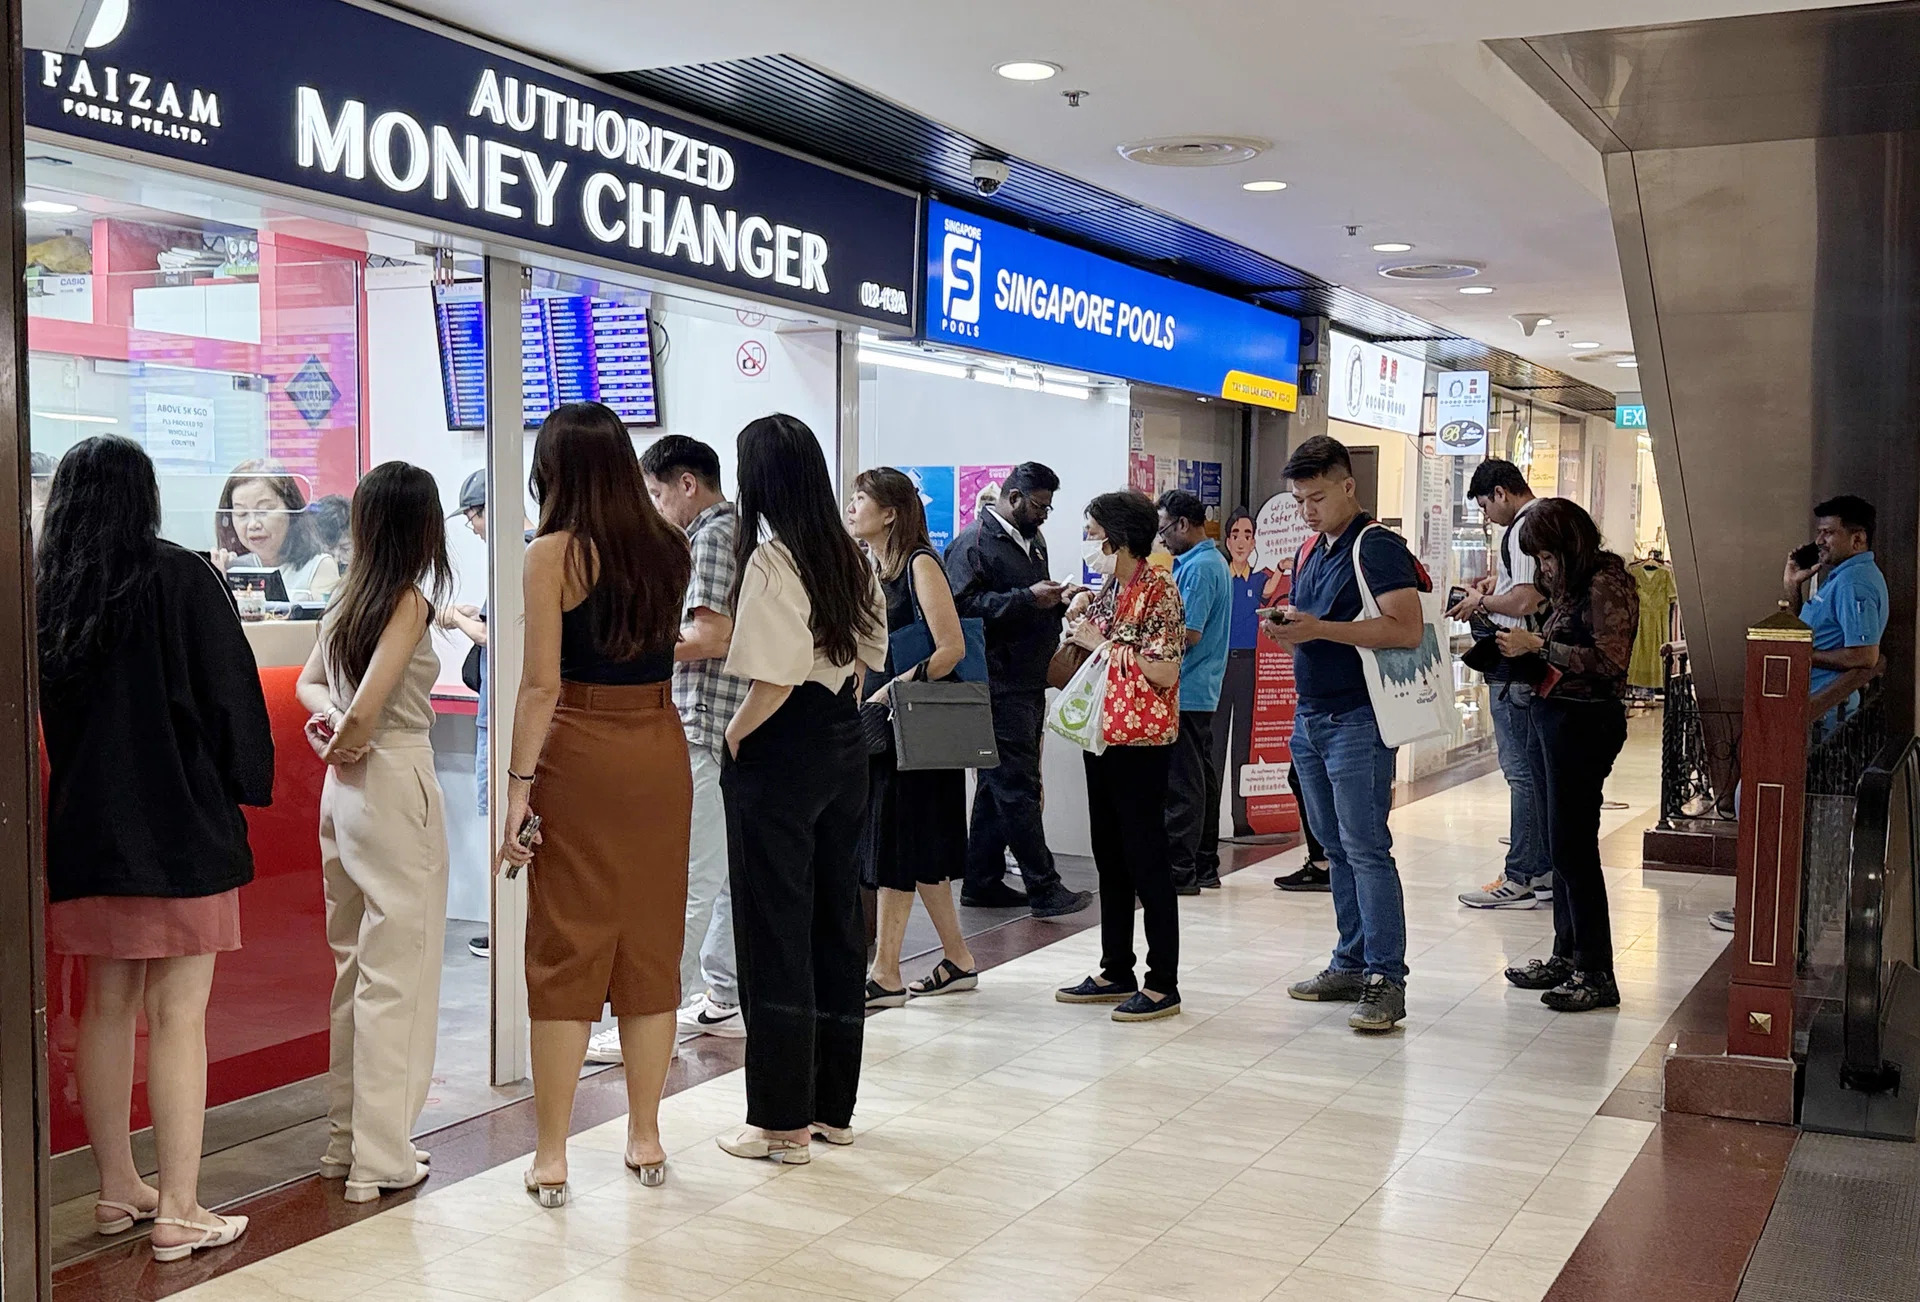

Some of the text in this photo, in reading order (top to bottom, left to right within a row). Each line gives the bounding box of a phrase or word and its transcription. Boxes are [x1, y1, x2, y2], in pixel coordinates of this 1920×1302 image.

[42, 51, 221, 127] FAIZAM
[63, 98, 123, 126] FOREX
[469, 68, 735, 191] AUTHORIZED
[297, 86, 830, 294] MONEY CHANGER
[944, 218, 981, 241] SINGAPORE
[60, 278, 85, 286] CASIO
[994, 268, 1176, 351] SINGAPORE POOLS
[941, 318, 979, 338] POOLS
[157, 404, 181, 414] ABOVE
[1622, 409, 1647, 426] EXI
[1271, 511, 1292, 525] Safer
